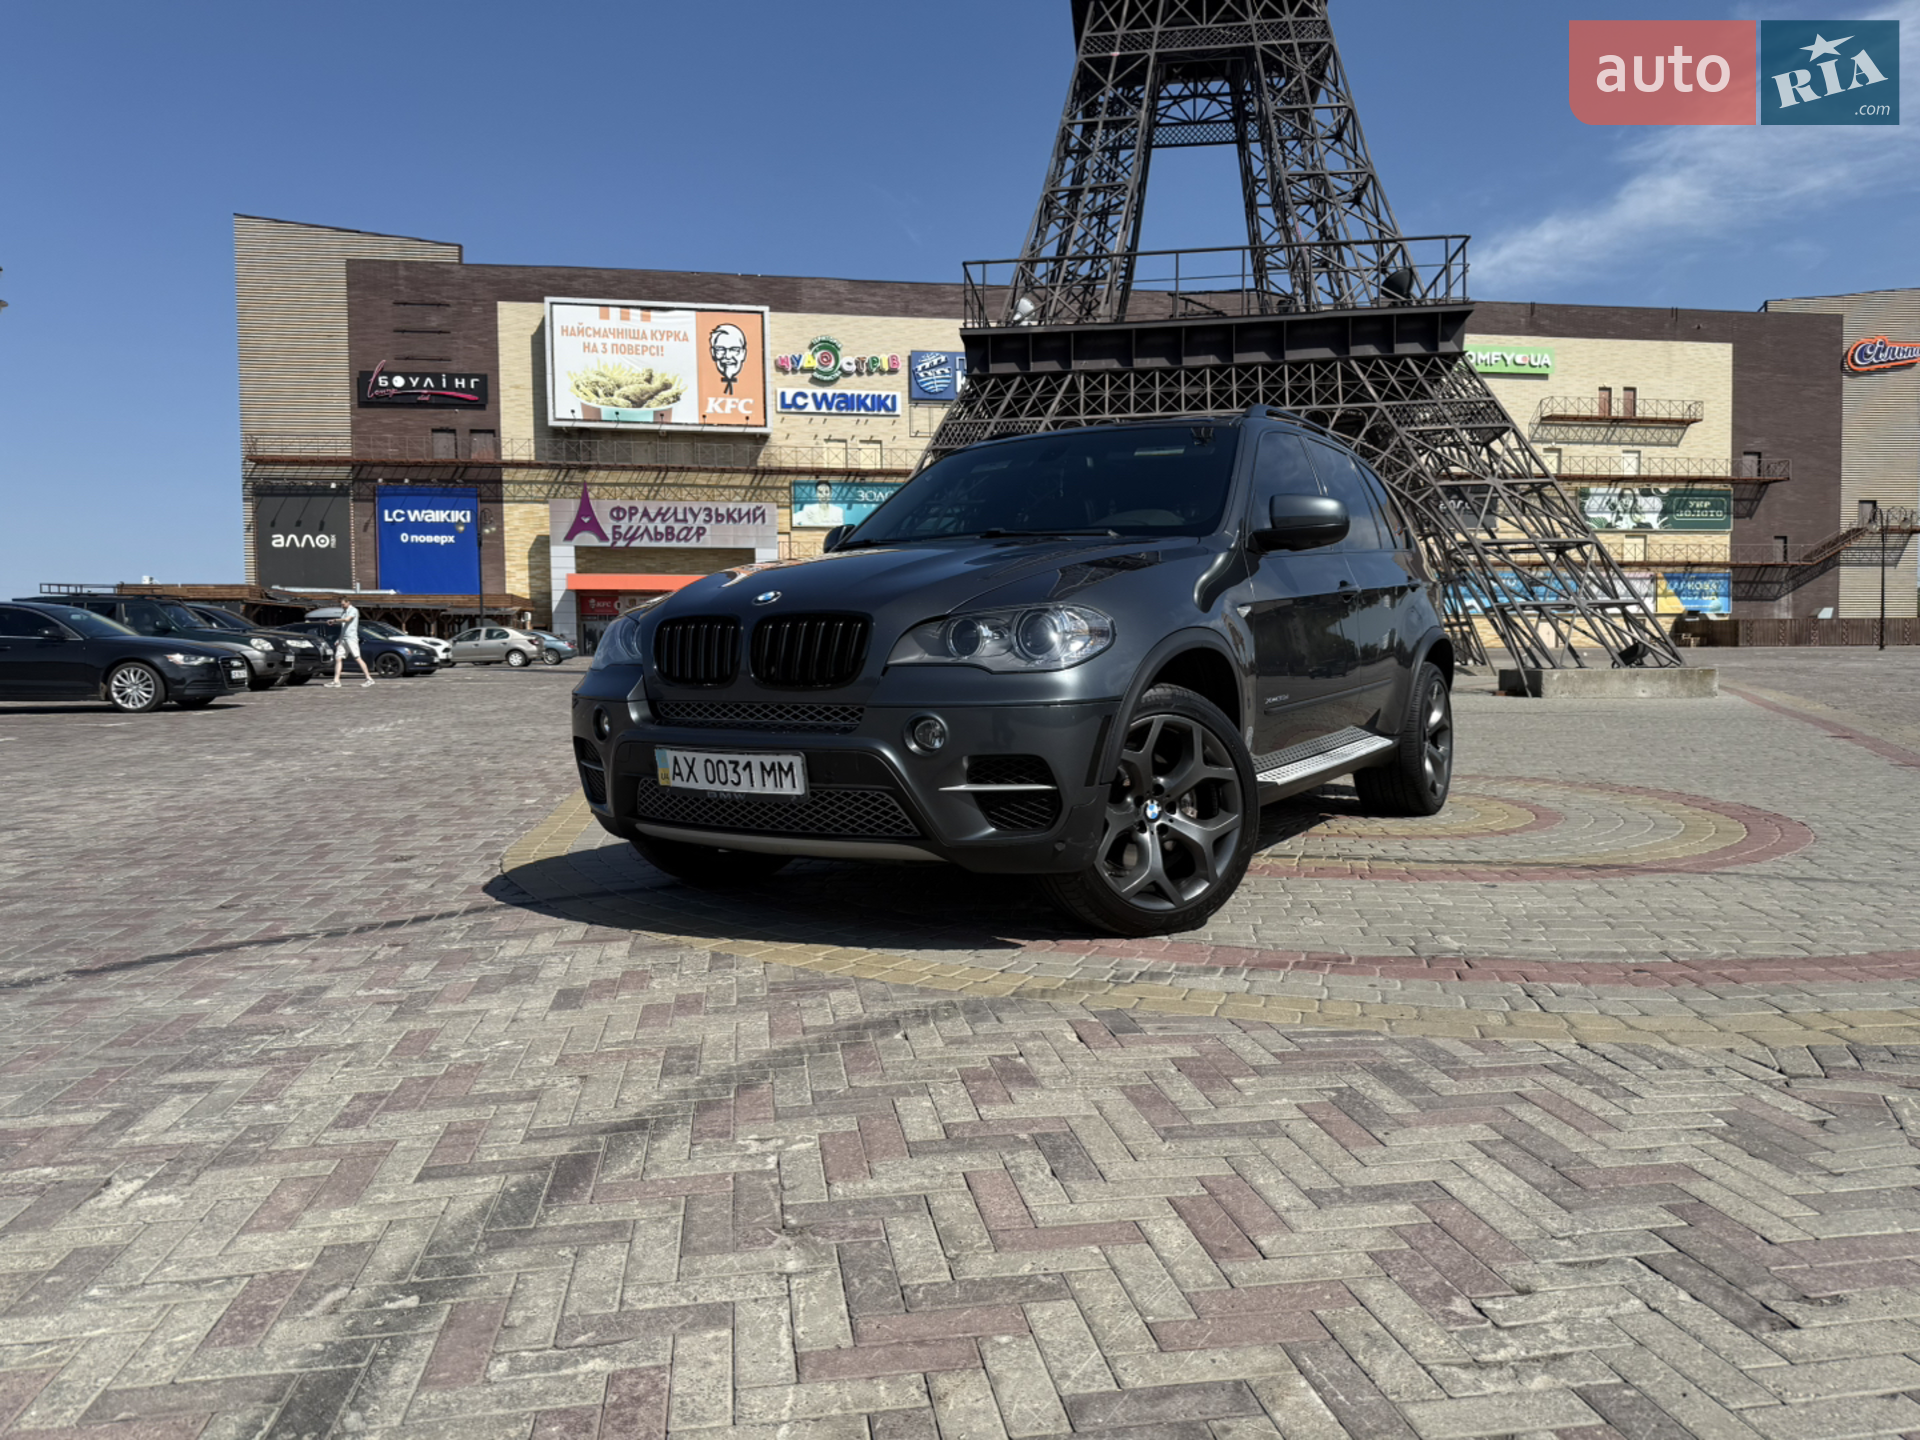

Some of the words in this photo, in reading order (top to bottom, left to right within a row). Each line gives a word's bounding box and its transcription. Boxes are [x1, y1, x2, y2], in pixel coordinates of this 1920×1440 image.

[560, 322, 648, 342] НАЙСМАЧНІША
[650, 330, 689, 342] КУРКА
[583, 342, 598, 354] НА
[600, 343, 608, 354] 3
[611, 343, 664, 357] ПОВЕРСІ!
[1464, 351, 1515, 366] OMFY
[705, 397, 754, 414] KFC
[780, 392, 808, 410] LC
[384, 509, 405, 522] LC
[609, 505, 766, 525] ФРАНЦУЗЬКИЙ
[411, 534, 454, 546] поверх
[672, 755, 698, 784] AX
[704, 758, 756, 787] 0031
[760, 760, 796, 789] MM
[706, 790, 747, 800] BMW
